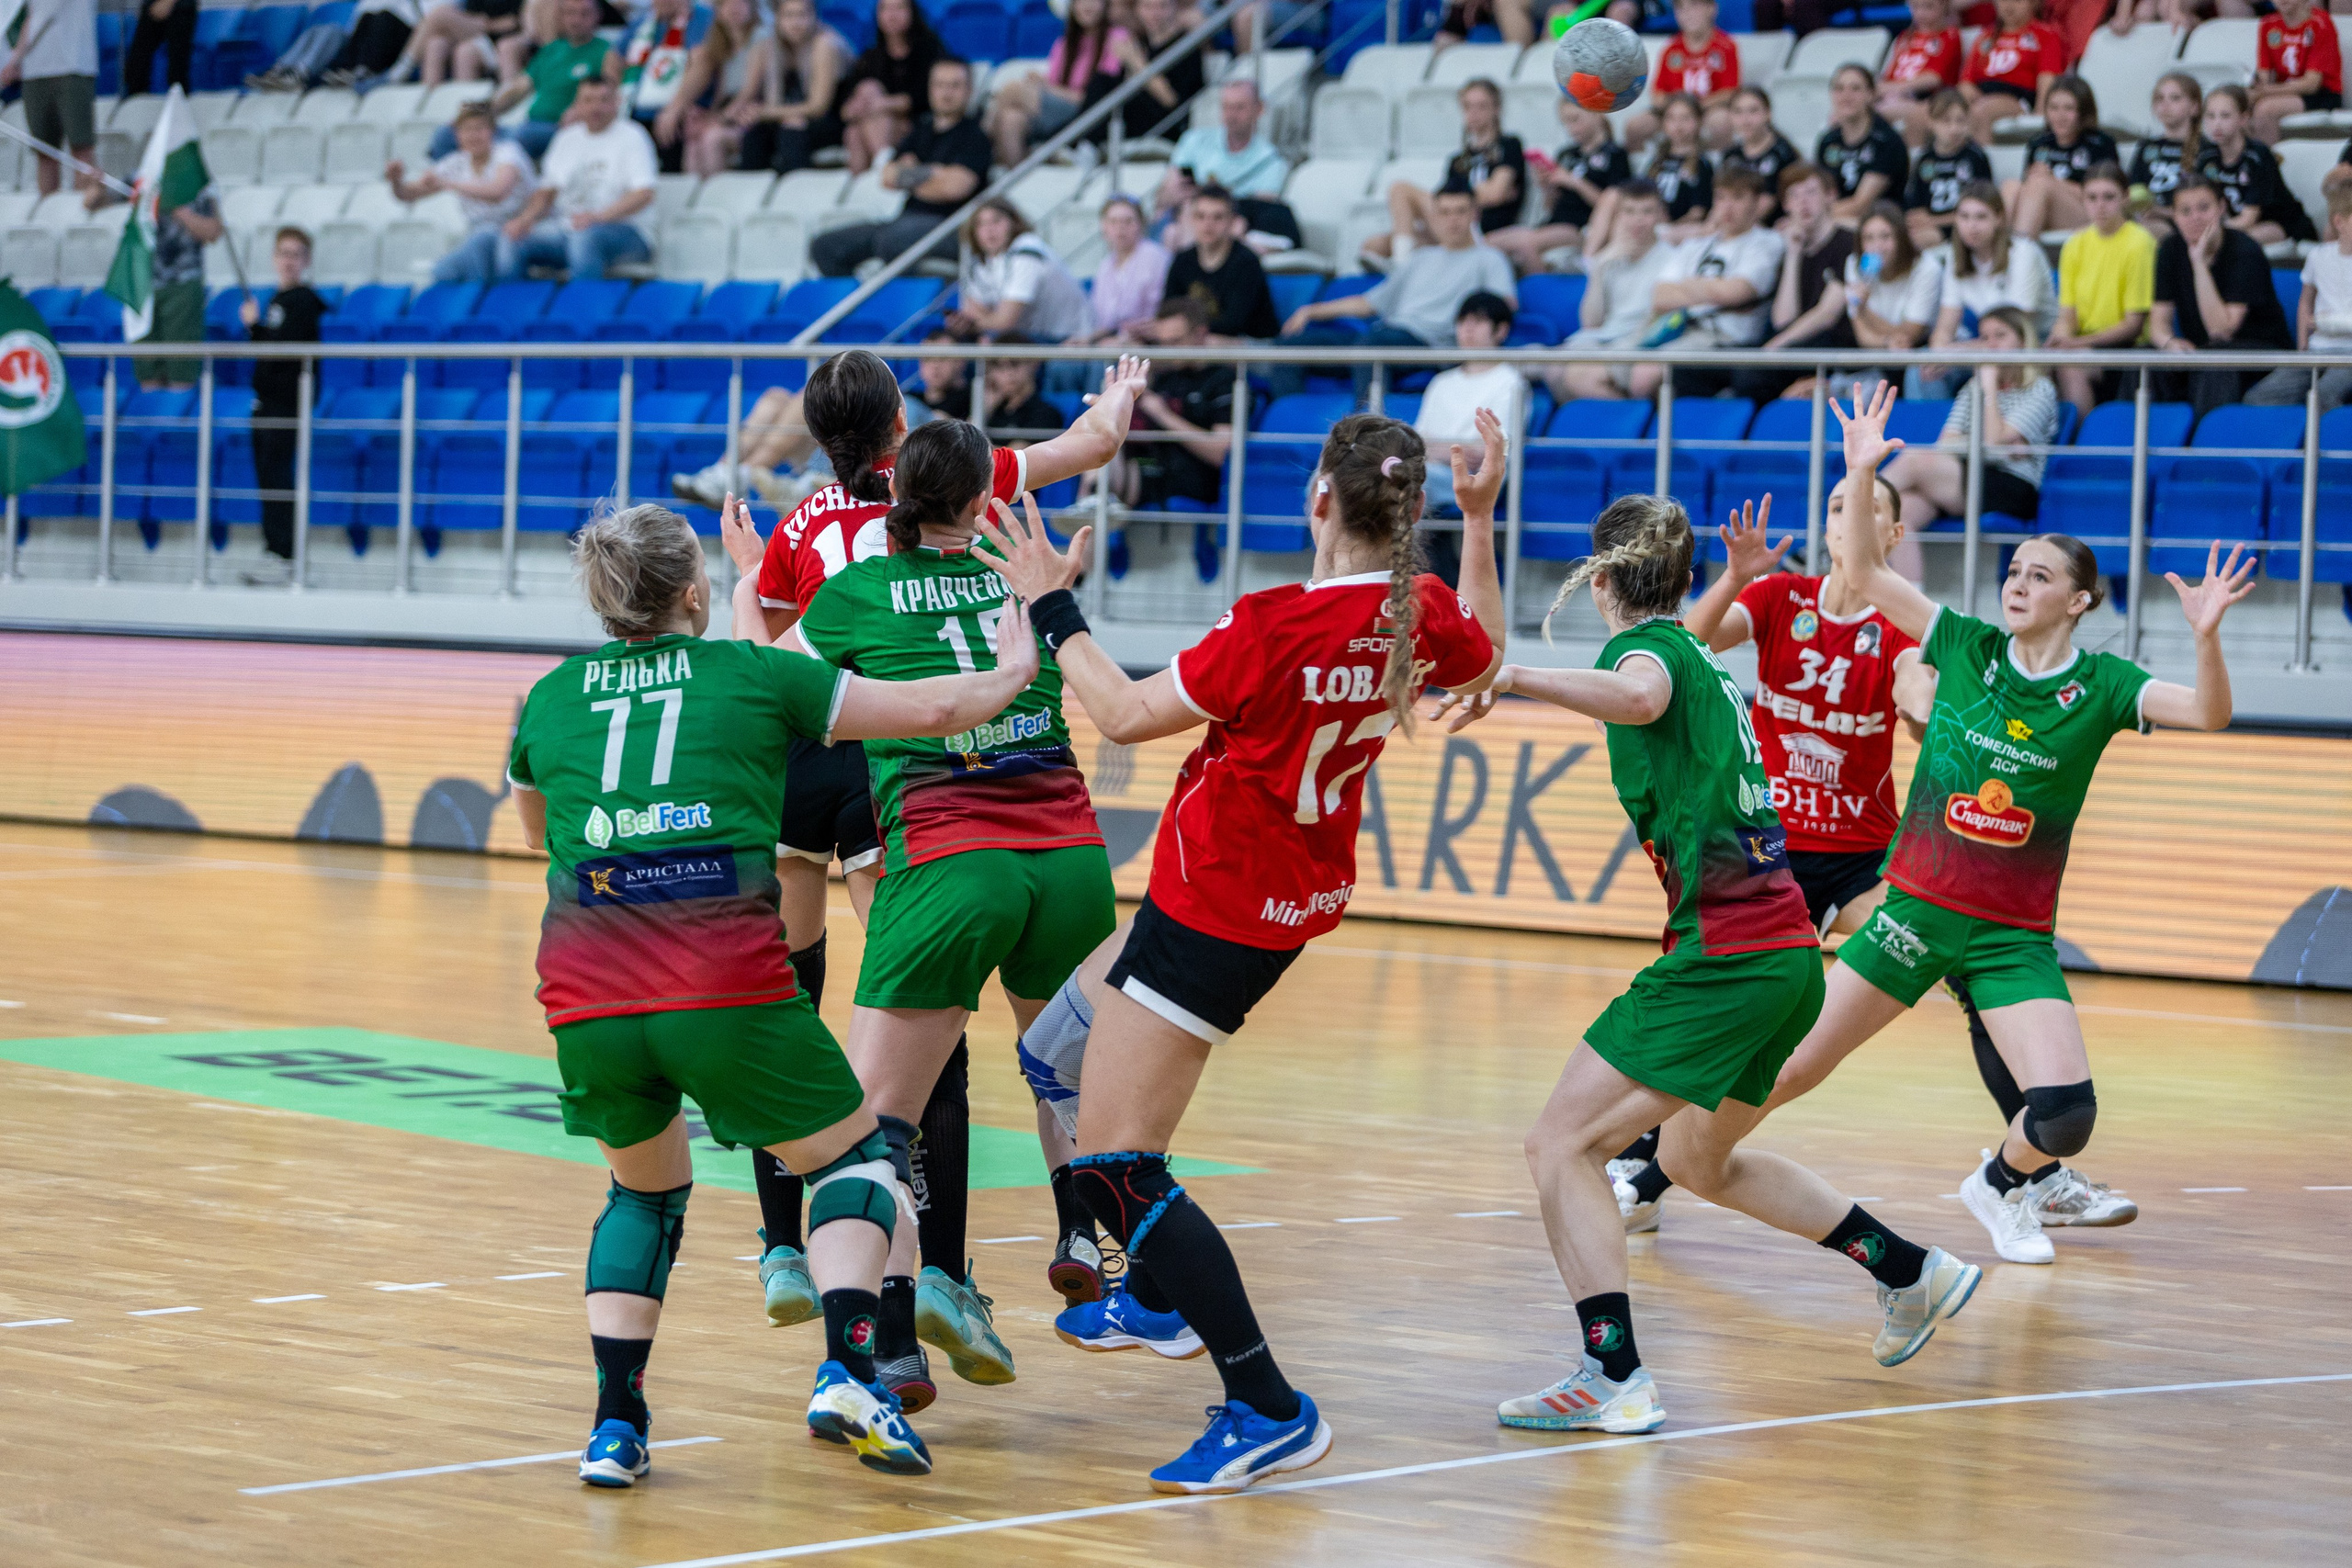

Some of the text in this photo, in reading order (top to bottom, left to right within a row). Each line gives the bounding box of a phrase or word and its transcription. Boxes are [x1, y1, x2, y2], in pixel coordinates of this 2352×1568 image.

[582, 648, 693, 694] РЕДЬКА
[1784, 647, 1852, 705] 34
[590, 687, 684, 794] 77
[976, 706, 1052, 749] BelFert
[1964, 729, 2058, 771] ГОМЕЛЬСКИЙ
[1990, 757, 2021, 775] ДСК
[617, 805, 710, 836] BelFert
[1950, 799, 2028, 835] Спартак
[626, 861, 722, 882] КРИСТАЛЛ
[1880, 940, 1917, 969] ГОМЕЛЯ
